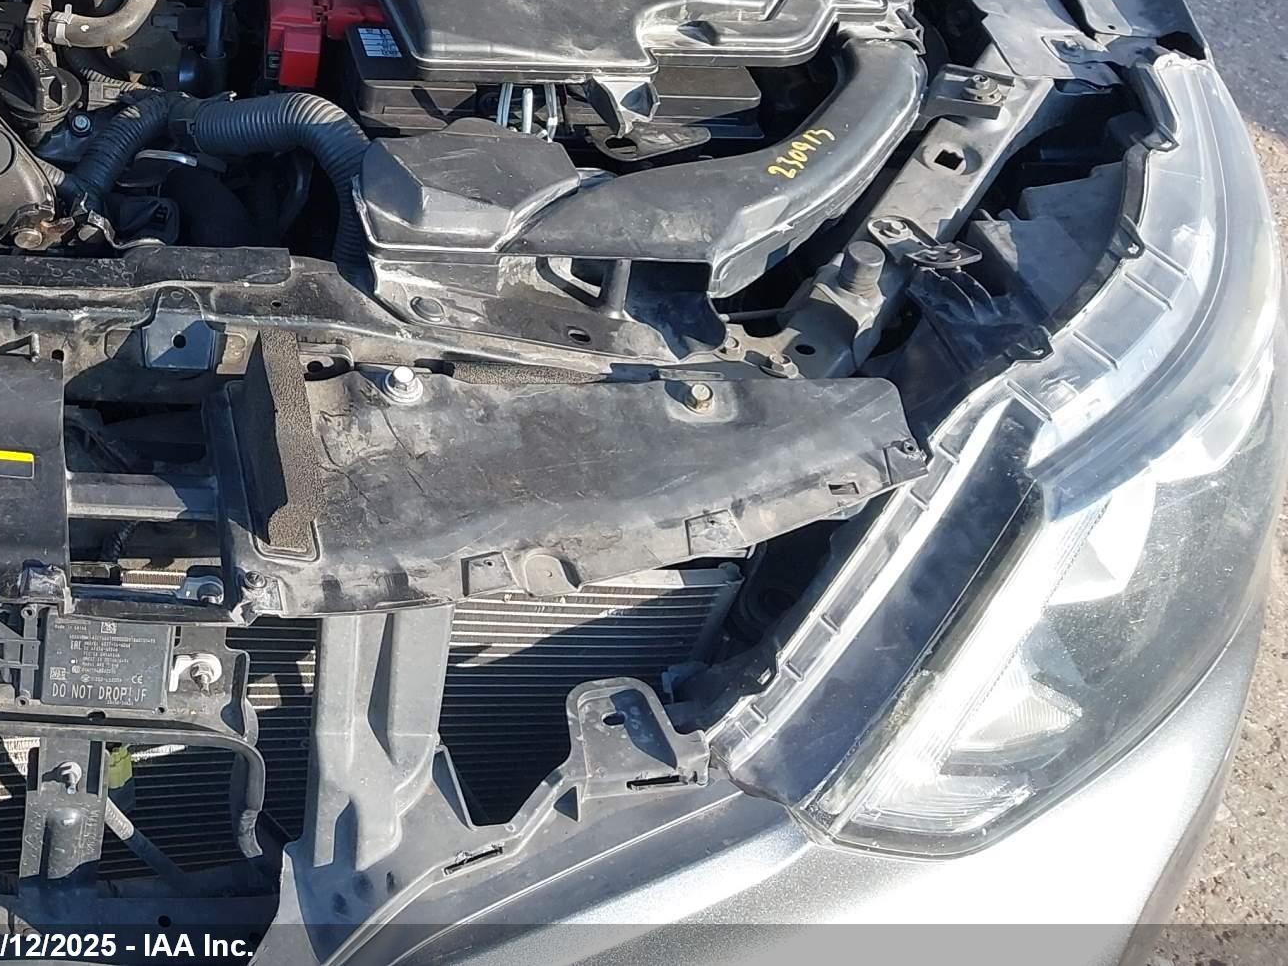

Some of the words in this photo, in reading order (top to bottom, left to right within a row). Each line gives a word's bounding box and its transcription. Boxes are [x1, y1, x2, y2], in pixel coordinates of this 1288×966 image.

[52, 682, 66, 698] DO
[72, 683, 93, 699] NOT
[98, 685, 132, 702] DROP!
[134, 688, 148, 702] JF
